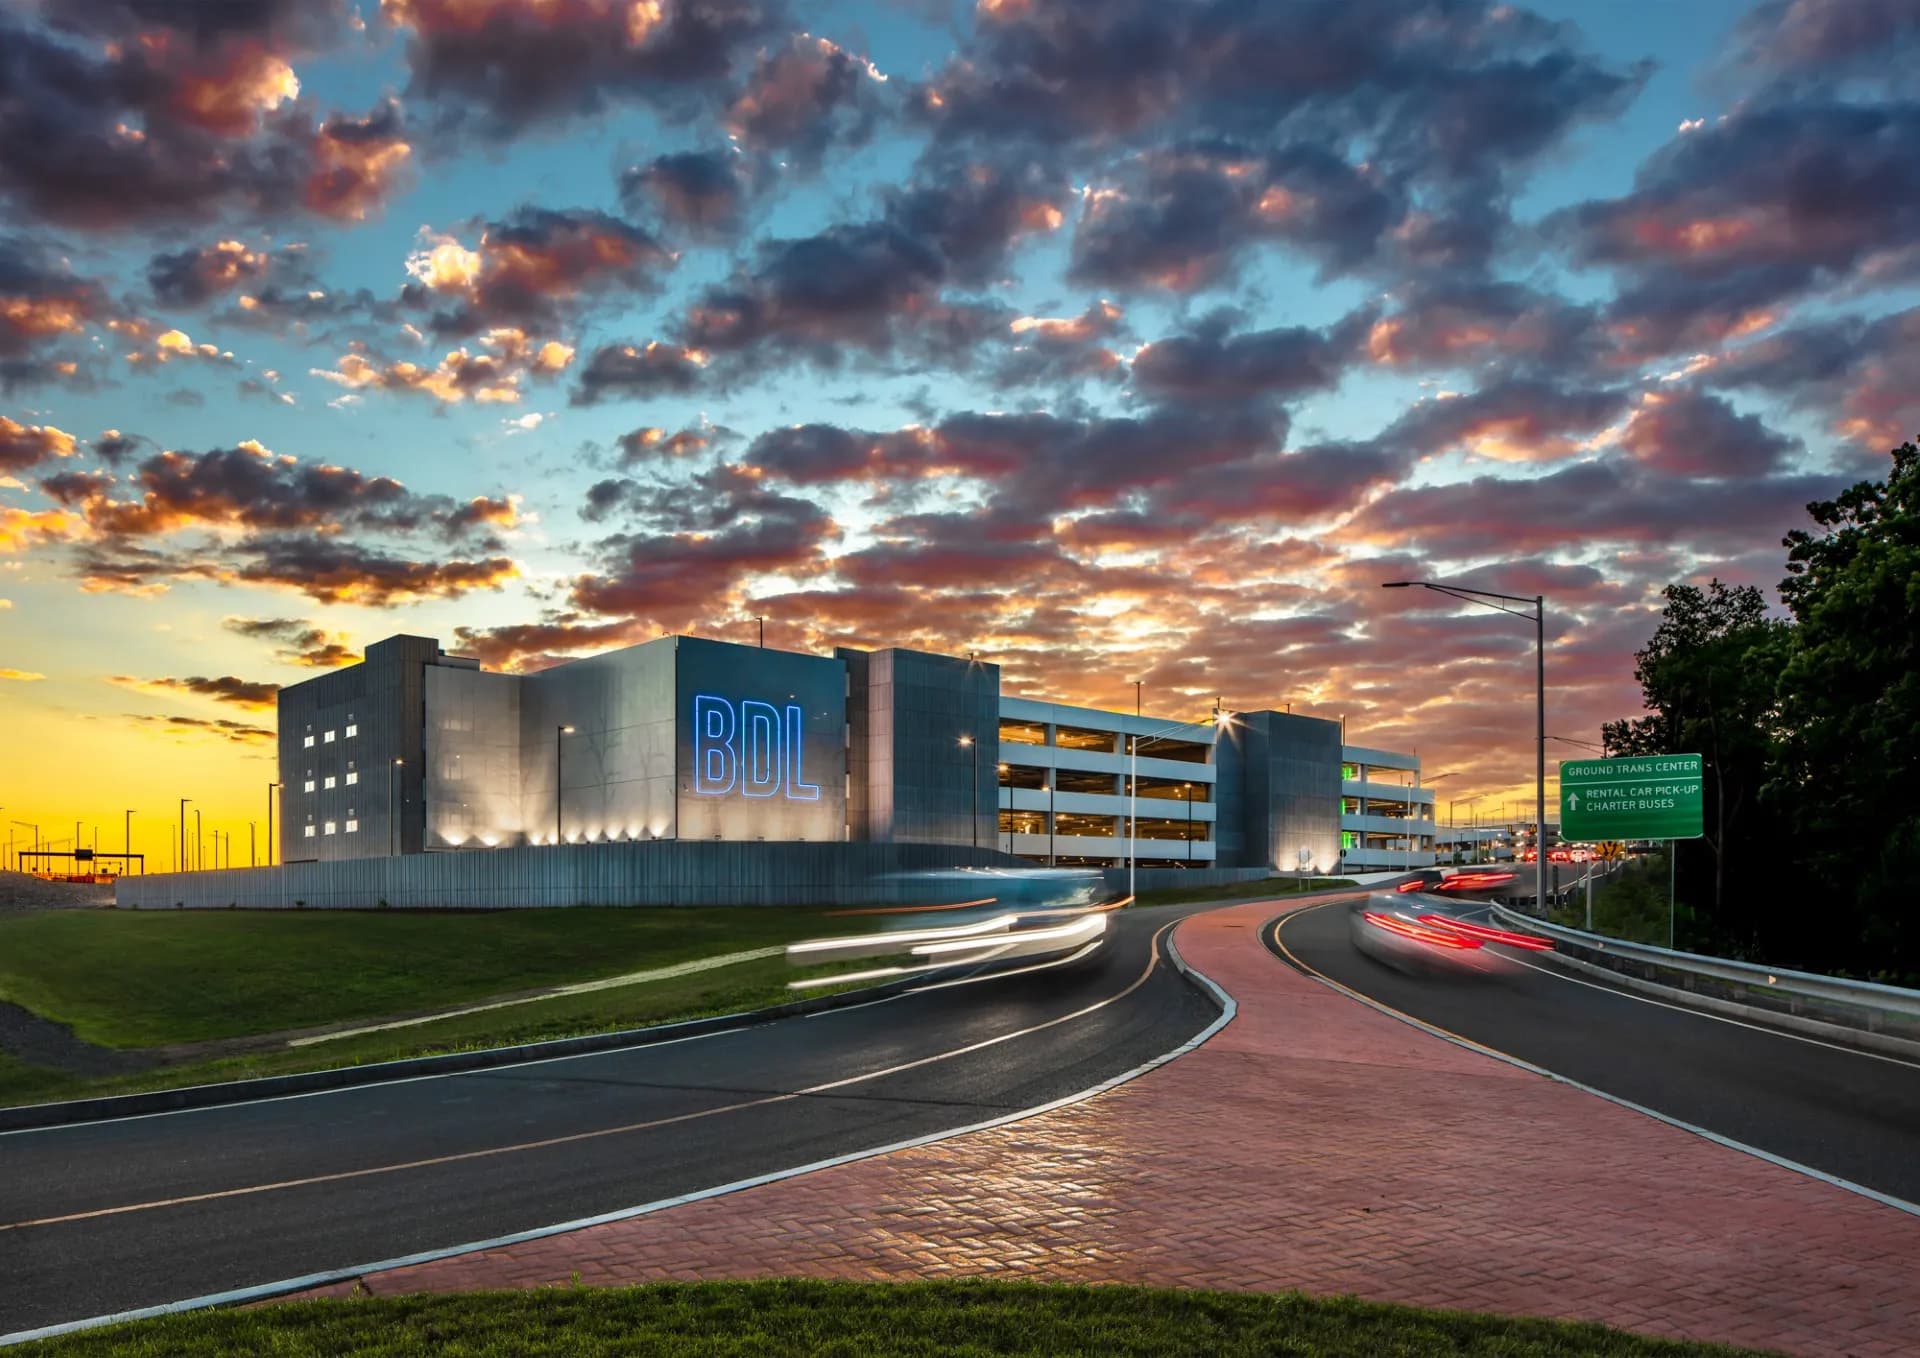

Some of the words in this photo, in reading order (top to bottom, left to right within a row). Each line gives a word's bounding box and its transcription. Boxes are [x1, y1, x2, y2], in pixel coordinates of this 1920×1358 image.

[695, 694, 820, 800] BDL
[1568, 765, 1613, 776] GROUND
[1616, 763, 1652, 774] TRANS
[1655, 761, 1698, 772] CENTER
[1586, 789, 1626, 799] RENTAL
[1630, 787, 1652, 797] CAR
[1655, 785, 1699, 795] PICK-UP
[1586, 801, 1636, 812] CHARTER
[1639, 799, 1674, 809] BUSES
